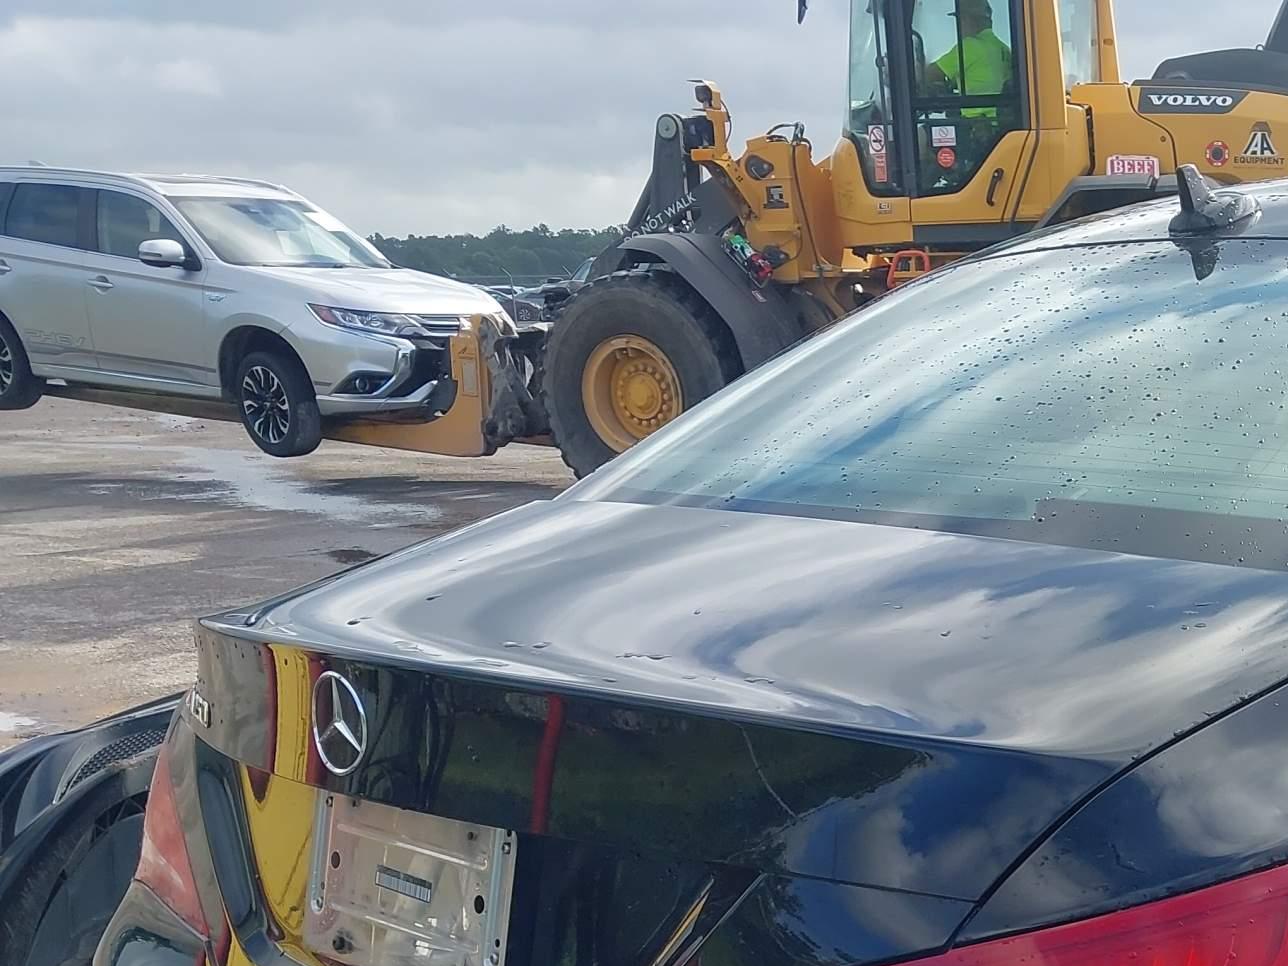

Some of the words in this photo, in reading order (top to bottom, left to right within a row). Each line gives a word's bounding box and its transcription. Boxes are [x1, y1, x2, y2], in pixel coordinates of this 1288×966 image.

[1148, 94, 1233, 107] VOLVO
[1113, 159, 1154, 175] BEEF
[1233, 156, 1286, 165] EQUIPMENT
[640, 212, 664, 235] NOT
[663, 191, 697, 217] WALK
[24, 328, 85, 347] PHEV
